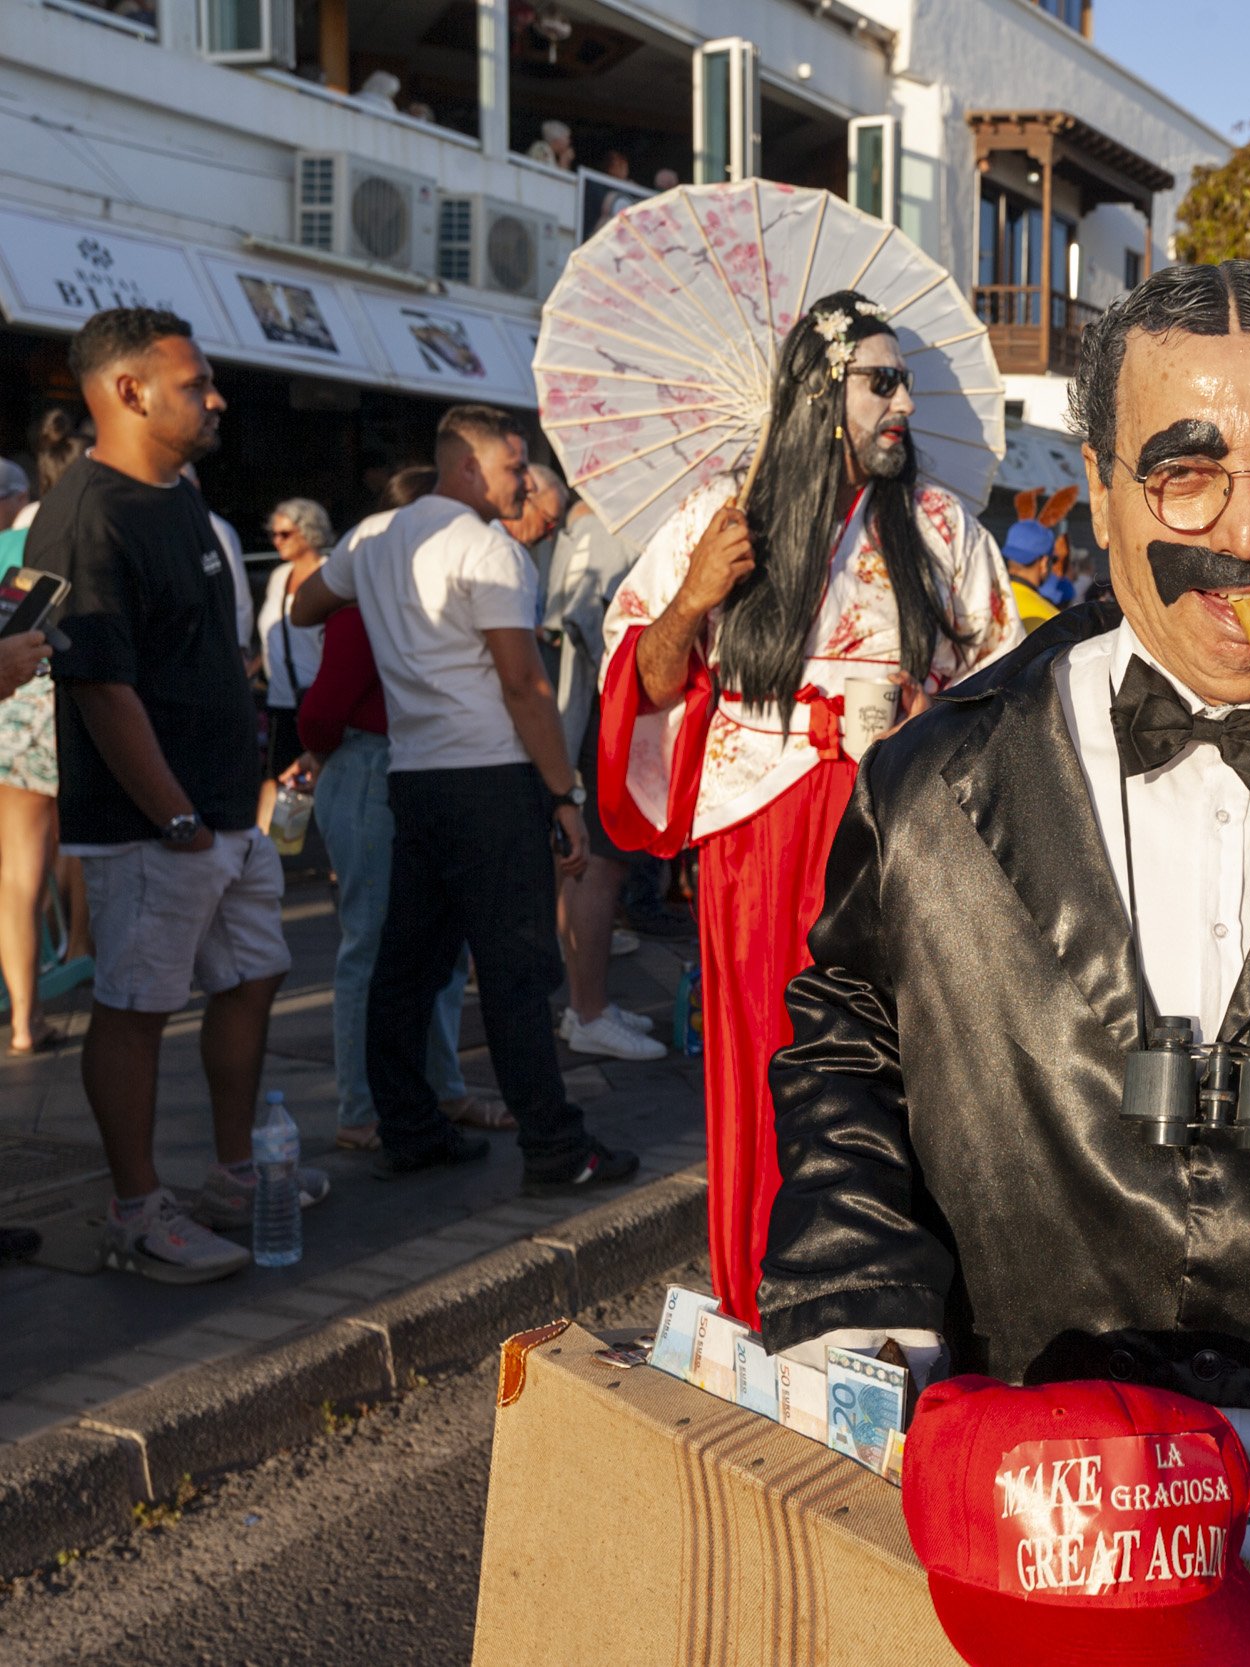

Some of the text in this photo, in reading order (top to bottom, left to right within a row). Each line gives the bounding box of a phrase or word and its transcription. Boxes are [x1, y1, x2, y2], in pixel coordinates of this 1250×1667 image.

[668, 1292, 679, 1310] 20
[699, 1316, 709, 1338] 50
[737, 1343, 747, 1364] 20
[780, 1364, 790, 1387] 50
[832, 1382, 857, 1435] 20
[1155, 1443, 1185, 1469] LA
[1001, 1455, 1231, 1519] MAKE GRACIOSA
[1016, 1524, 1228, 1592] GREAT AGAIN
